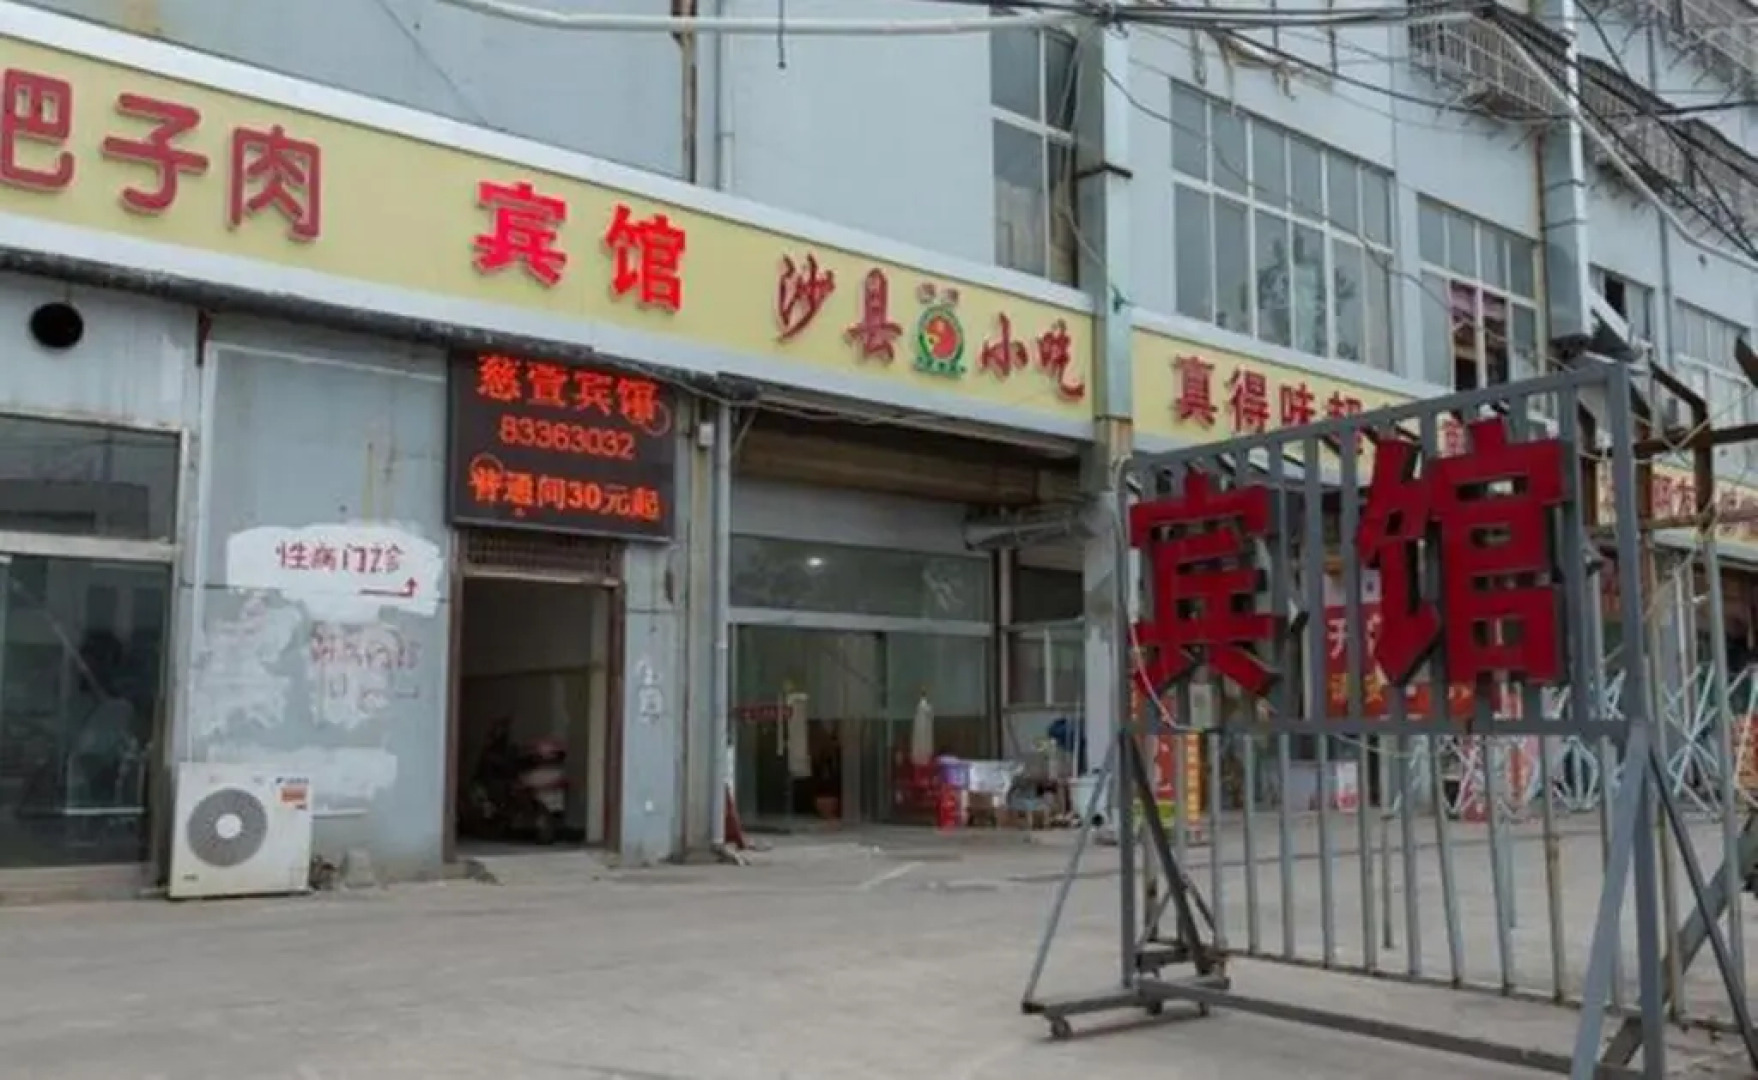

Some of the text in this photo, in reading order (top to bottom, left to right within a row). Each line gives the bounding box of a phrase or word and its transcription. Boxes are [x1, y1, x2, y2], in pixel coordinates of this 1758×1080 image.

[472, 182, 686, 312] 宾馆
[776, 254, 1085, 399] 沙县小吃
[499, 414, 636, 460] 83363032
[466, 464, 661, 520] 普通间30元起
[274, 540, 404, 574] 性病门诊
[1130, 420, 1568, 692] 宾馆
